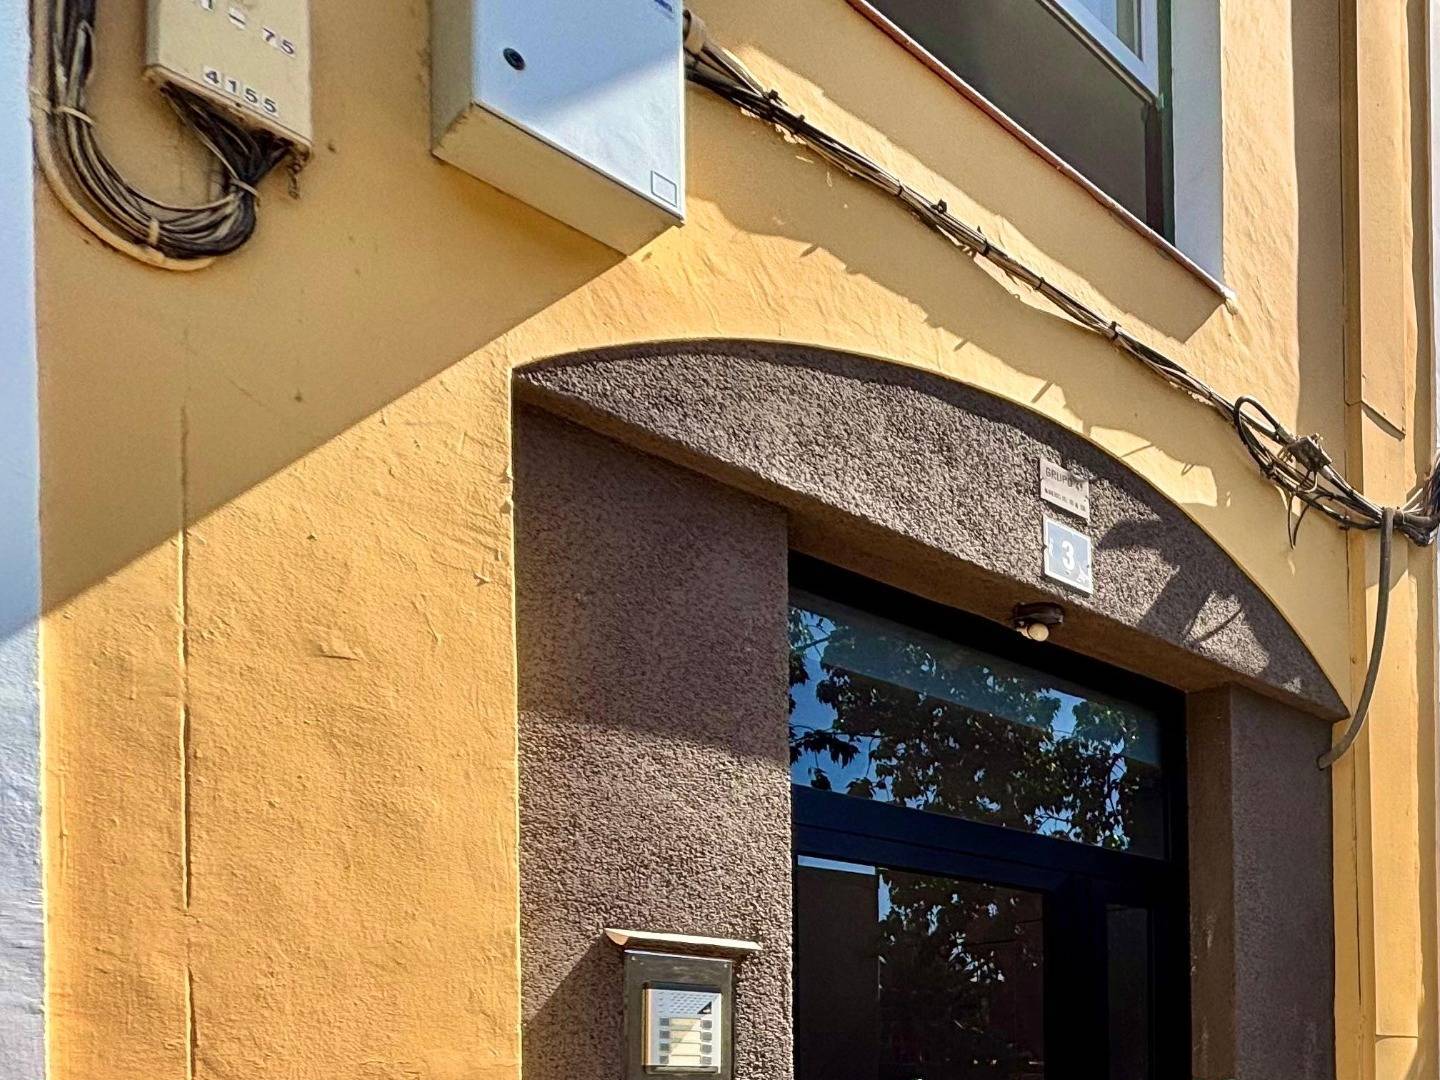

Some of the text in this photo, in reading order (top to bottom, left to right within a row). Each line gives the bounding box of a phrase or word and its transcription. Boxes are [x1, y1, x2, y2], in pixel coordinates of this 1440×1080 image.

[263, 27, 296, 55] 75
[205, 69, 278, 114] 4155
[1061, 539, 1076, 571] 3
